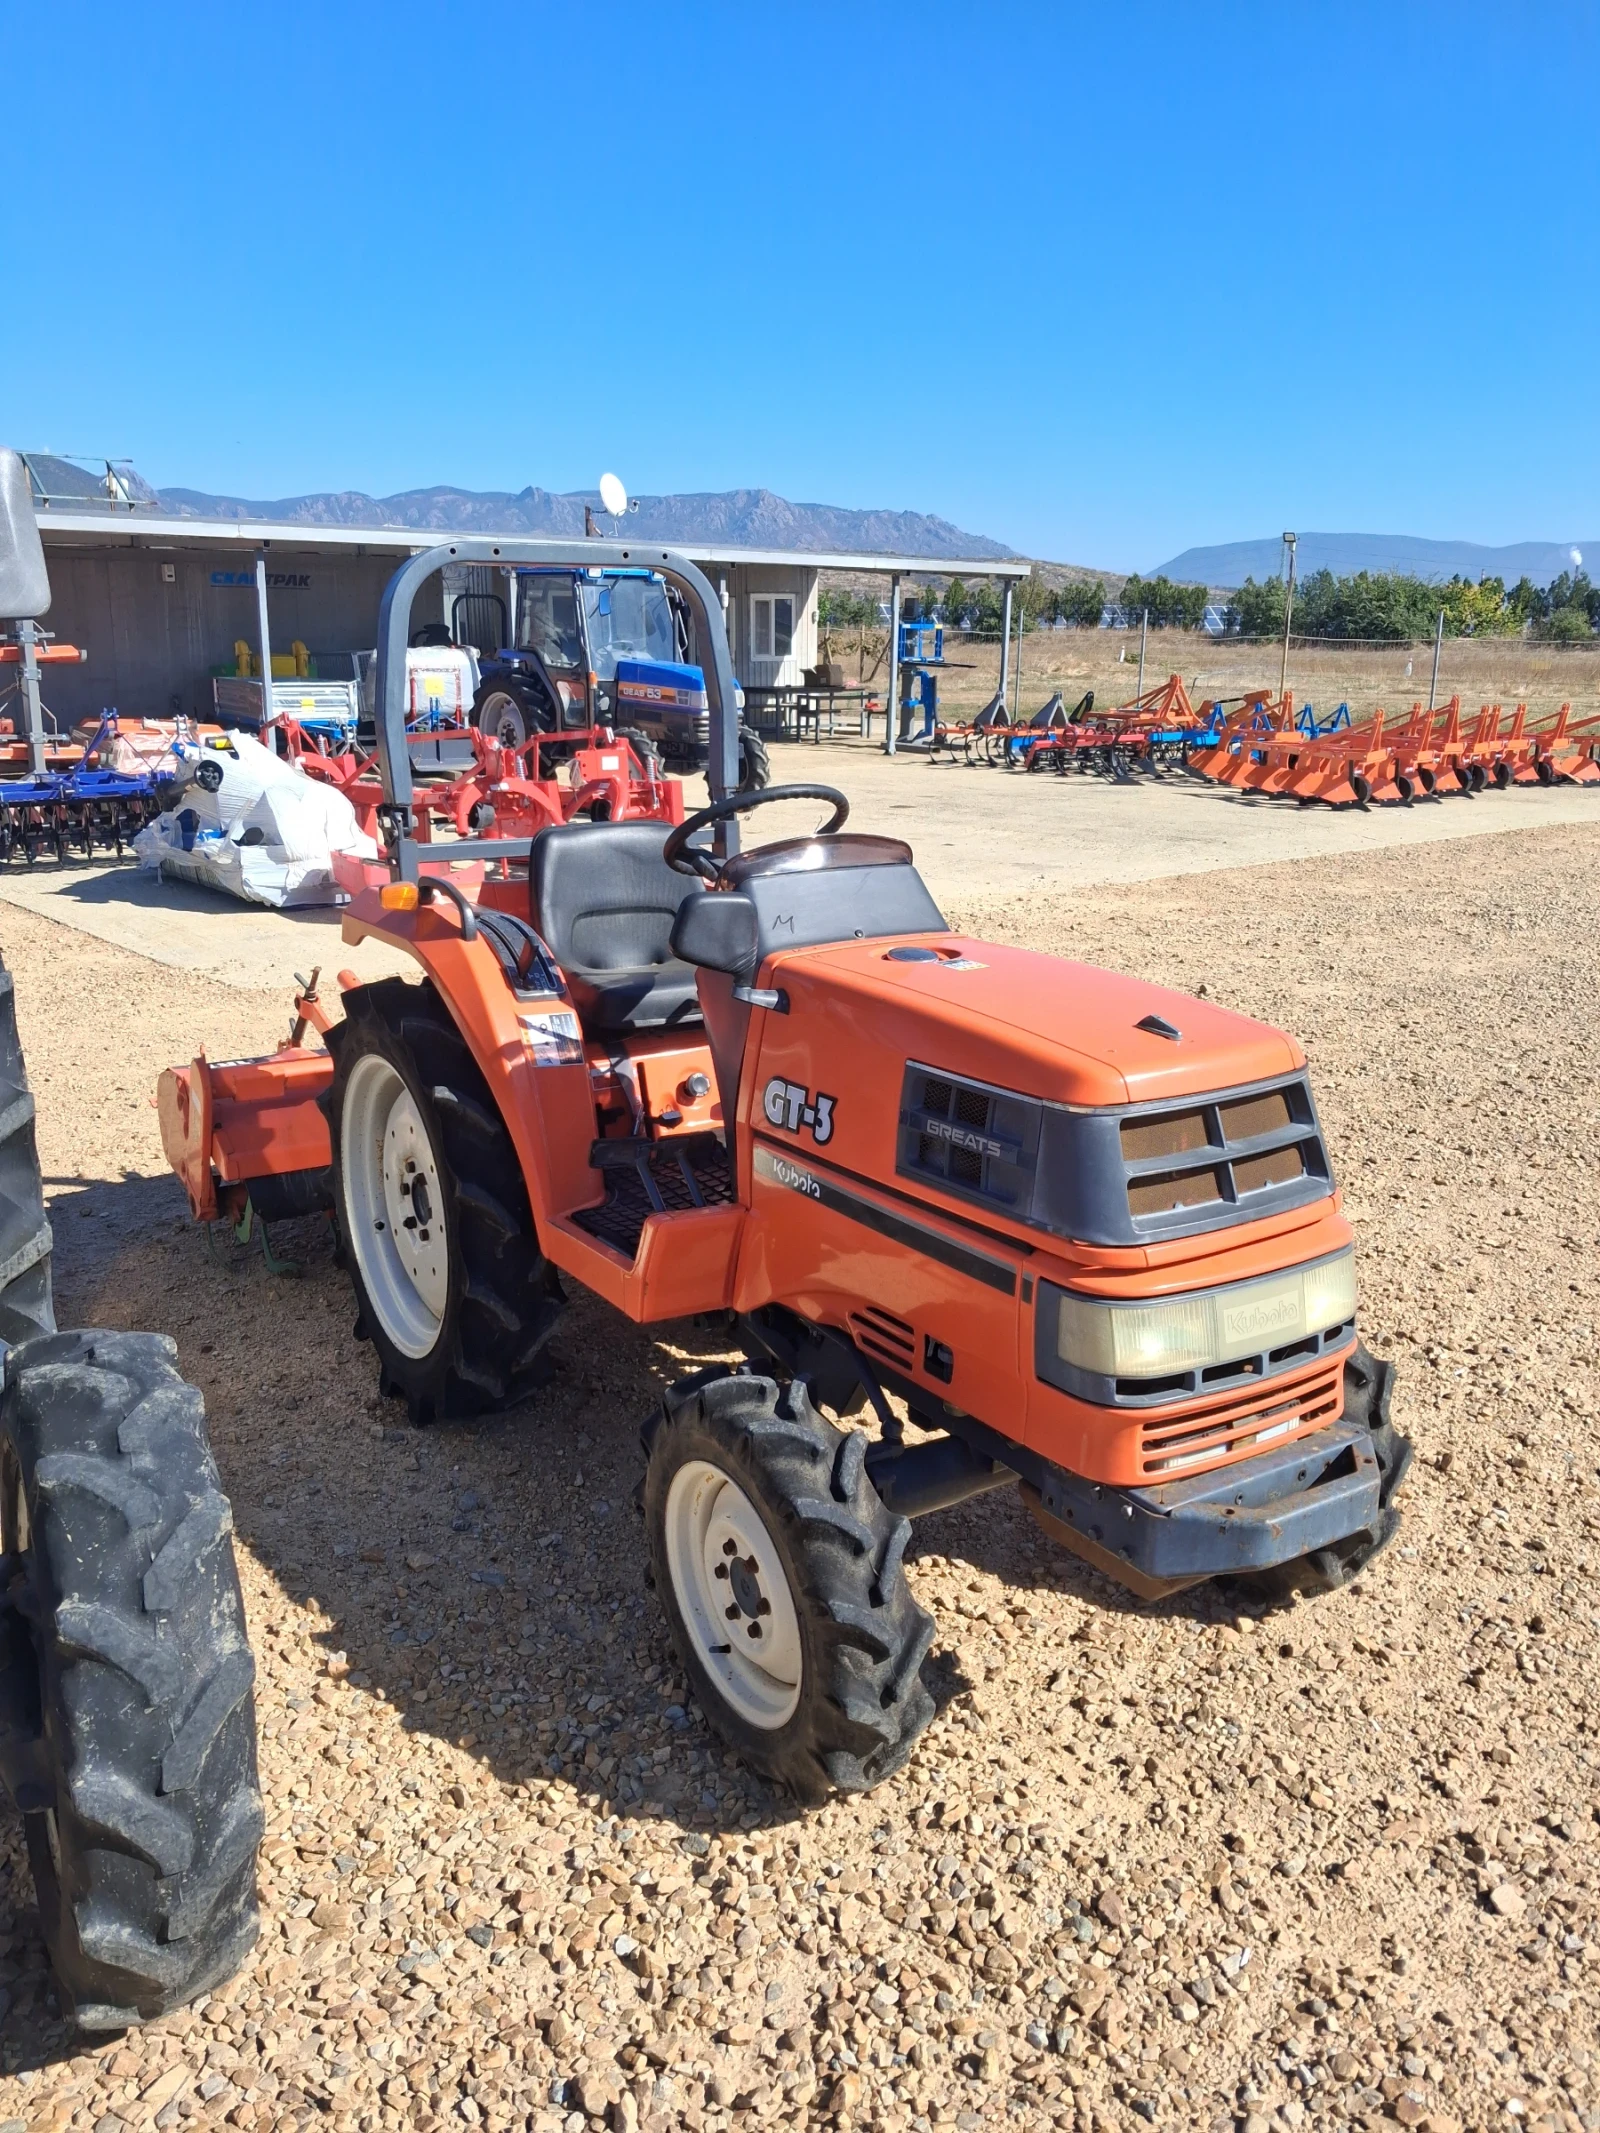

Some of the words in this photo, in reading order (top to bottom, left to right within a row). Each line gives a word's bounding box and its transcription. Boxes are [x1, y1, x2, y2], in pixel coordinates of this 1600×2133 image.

[646, 687, 662, 700] 53
[764, 1077, 837, 1145] GT-3
[926, 1119, 1001, 1157] GREATS
[772, 1157, 821, 1199] Kubota
[1227, 1300, 1298, 1336] Kubota
